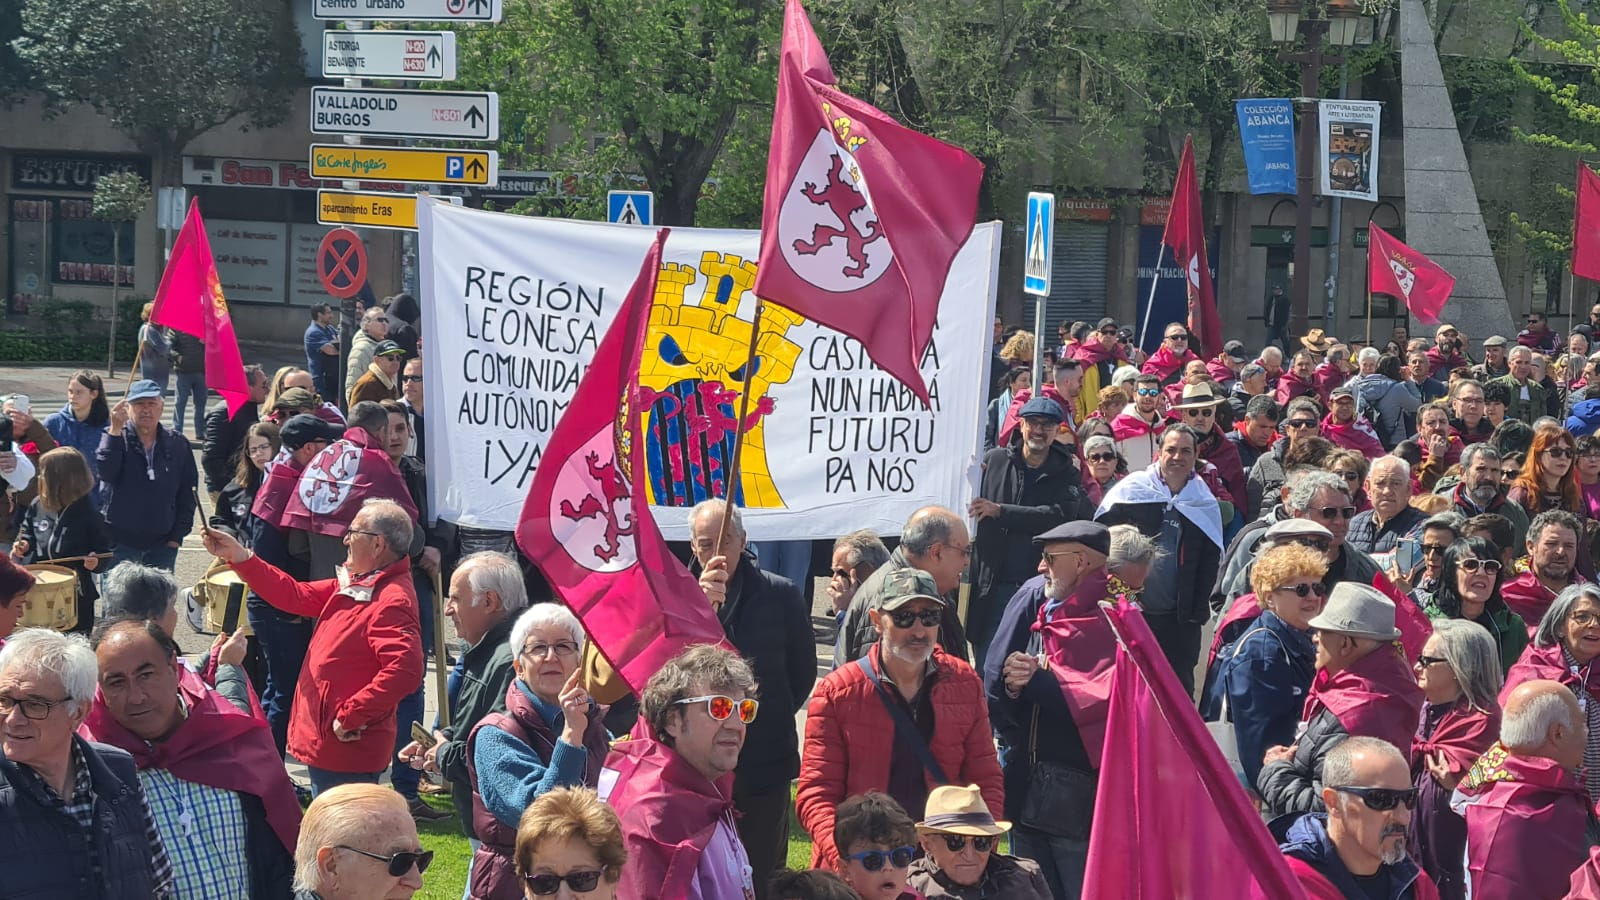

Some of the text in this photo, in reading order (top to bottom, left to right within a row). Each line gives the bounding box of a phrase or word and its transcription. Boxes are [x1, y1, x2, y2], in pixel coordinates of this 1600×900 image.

[328, 41, 360, 51] ASTORGA
[327, 57, 425, 71] BENAVENTE N-630
[317, 95, 398, 111] VALLADOLID
[1243, 104, 1289, 114] COLECCIÓN
[317, 109, 461, 126] BURGOS N-601
[1247, 114, 1291, 127] ABANCA
[327, 154, 351, 168] Corte
[222, 160, 273, 187] San
[322, 202, 392, 217] aparcamiento Eras
[464, 266, 604, 317] REGIÓN
[465, 303, 598, 354] LEONESA
[809, 335, 940, 371] CASTA
[463, 349, 589, 393] COMUNIDA
[811, 377, 862, 412] NUN
[808, 416, 935, 454] FUTURU
[825, 456, 917, 494] PA NÓS
